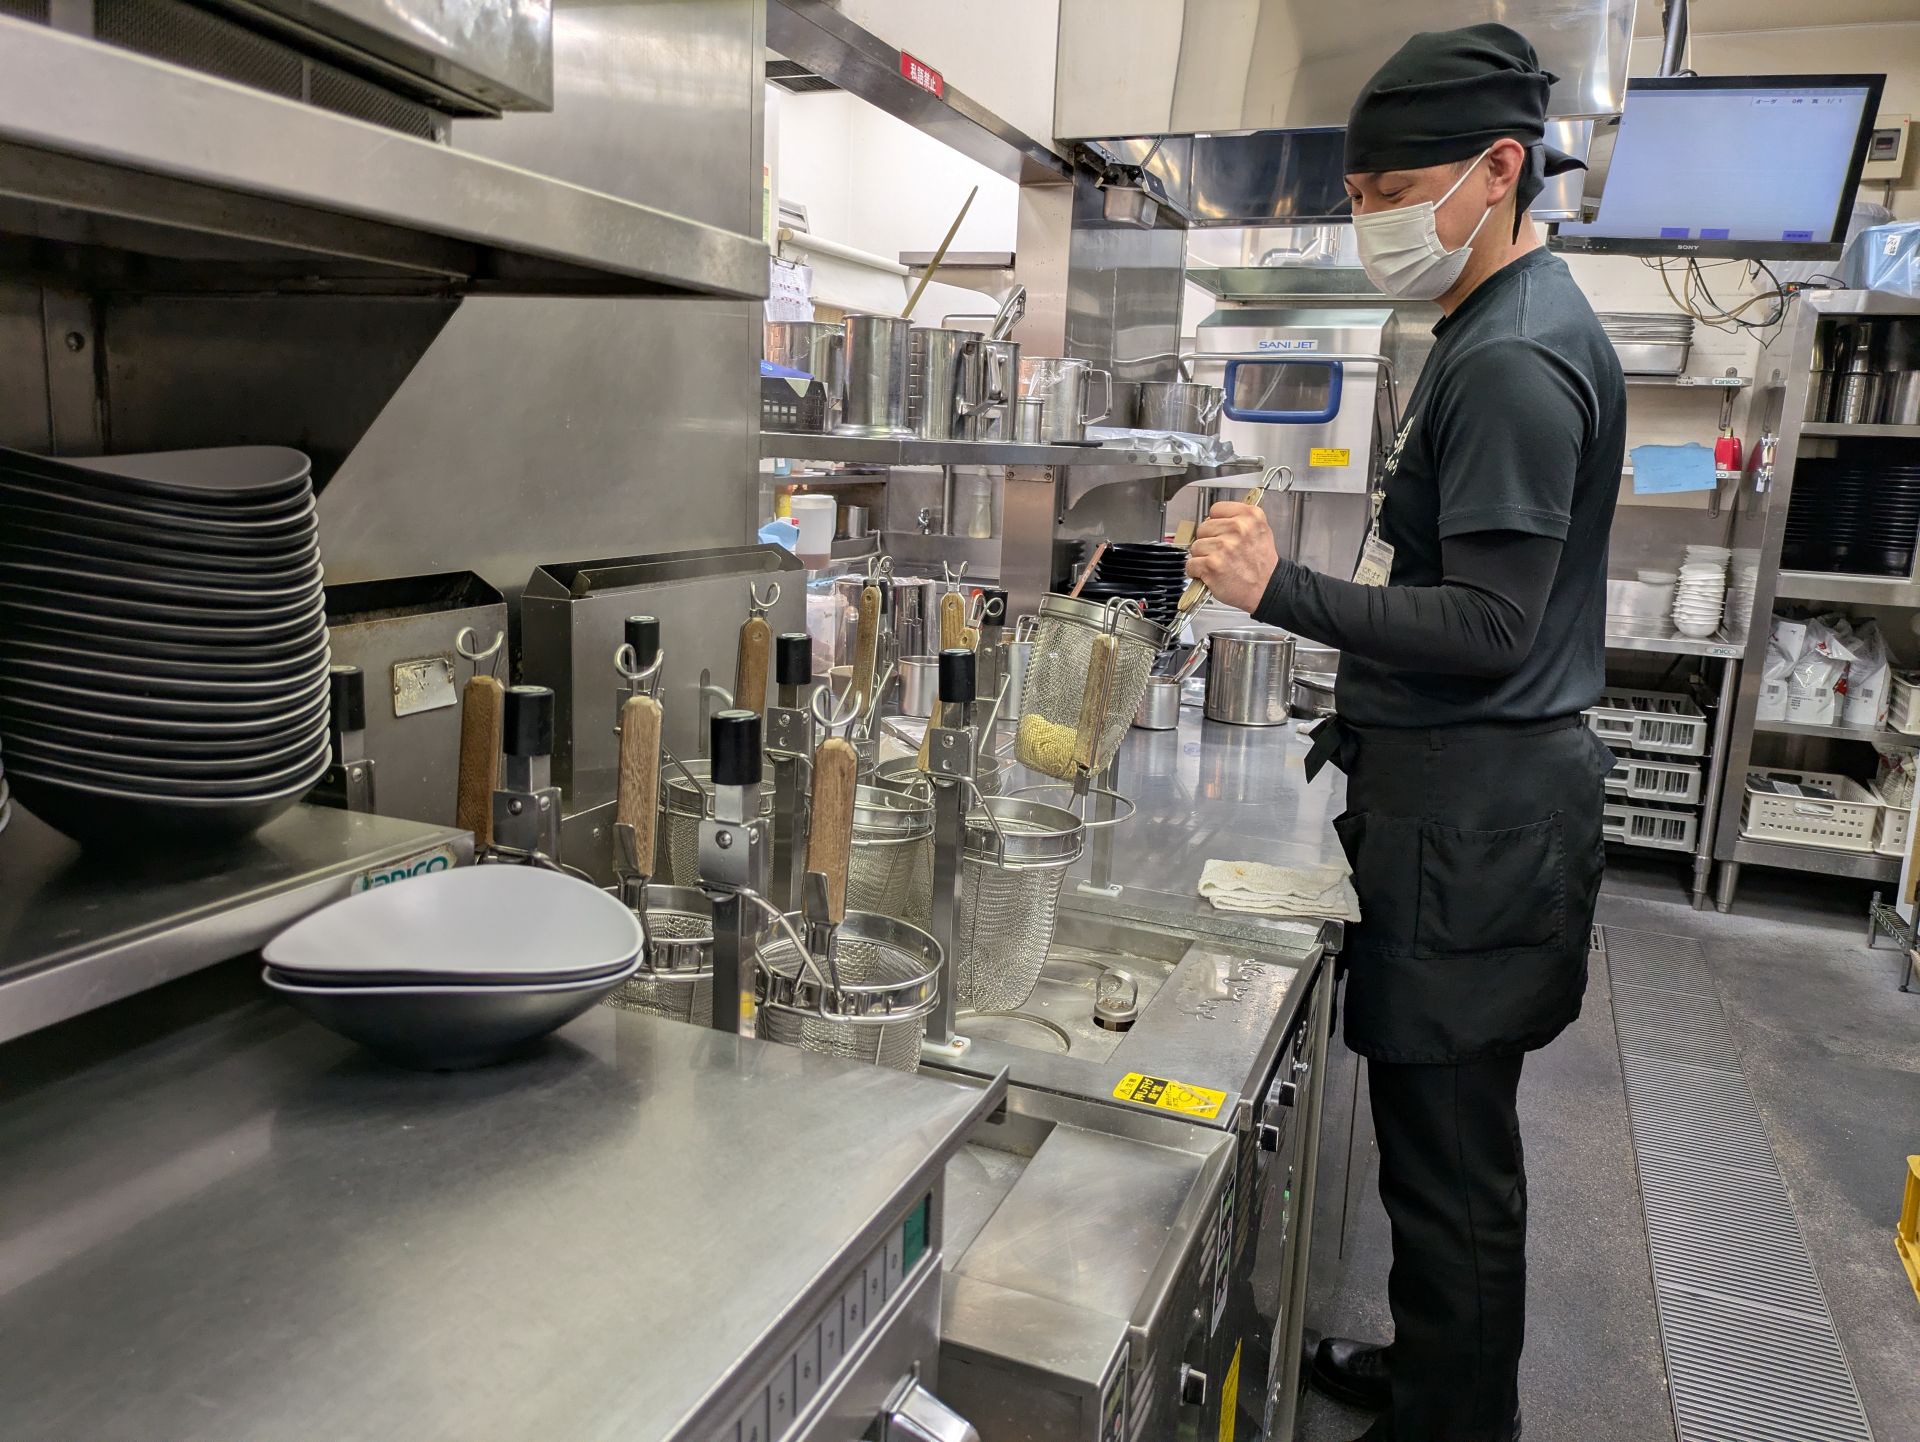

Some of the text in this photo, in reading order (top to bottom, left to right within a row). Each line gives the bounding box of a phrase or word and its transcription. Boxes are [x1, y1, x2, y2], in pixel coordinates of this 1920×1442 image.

[910, 62, 937, 92] 私語禁止
[1259, 341, 1315, 349] SANI JET
[850, 1302, 858, 1321] 8
